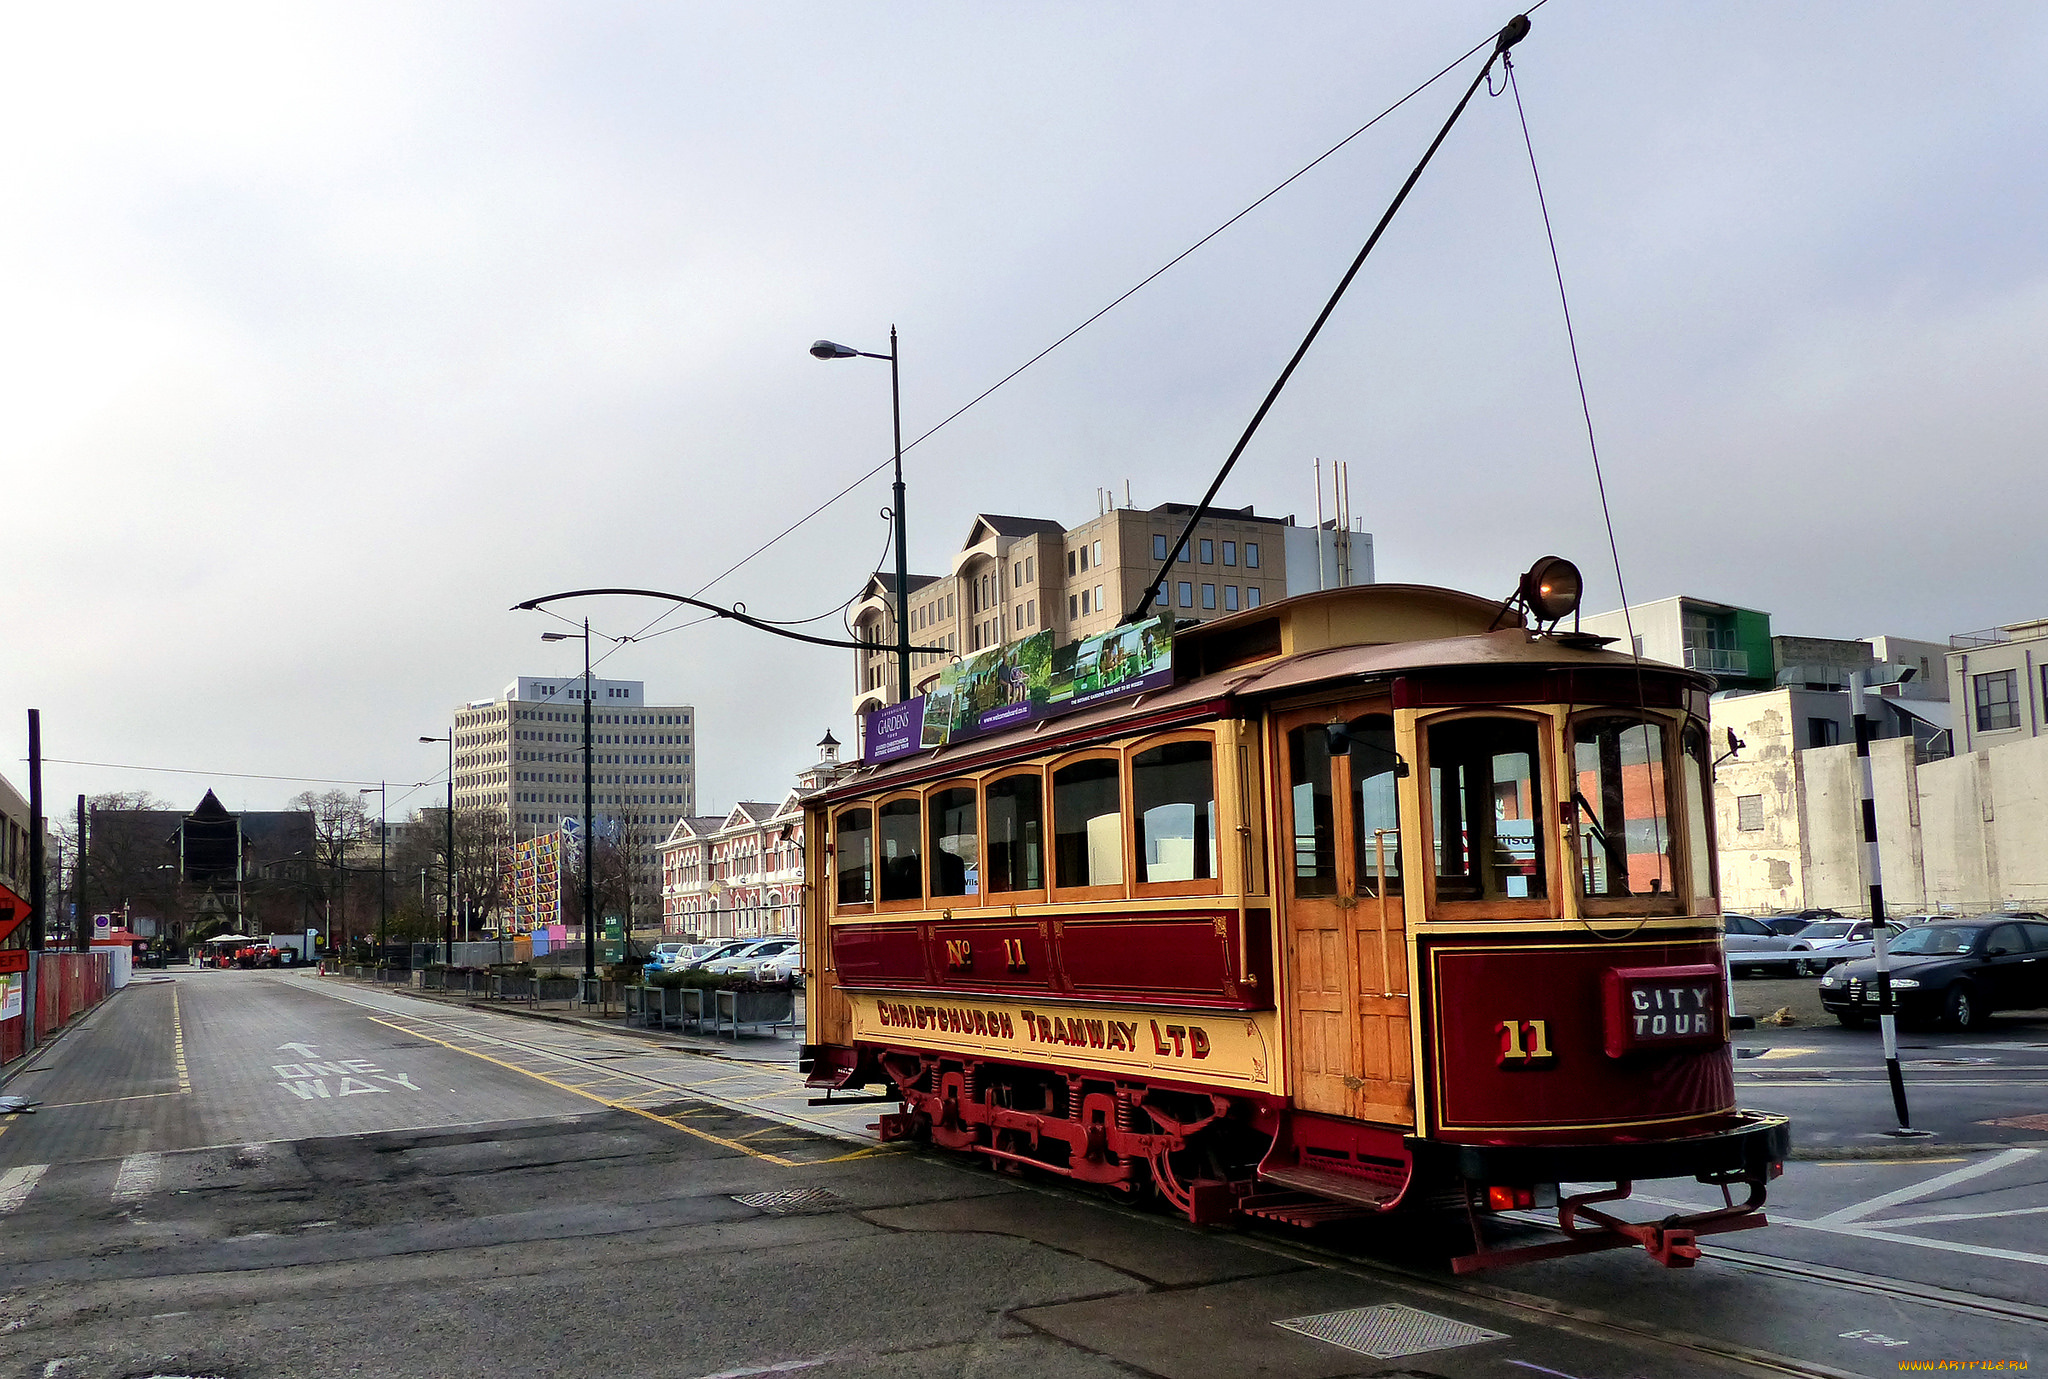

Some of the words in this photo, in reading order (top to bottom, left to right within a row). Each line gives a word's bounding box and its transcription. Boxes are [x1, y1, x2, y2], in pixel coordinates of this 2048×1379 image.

[877, 711, 909, 736] GARDENS
[0, 953, 24, 968] EFT
[1003, 938, 1027, 966] 11
[1631, 988, 1709, 1010] CITY
[876, 999, 1015, 1040] CHRISTCHURCH
[1020, 1009, 1139, 1053] TRAMWAY
[1149, 1018, 1211, 1060] LTD
[1632, 1014, 1709, 1035] TOUR
[1500, 1019, 1553, 1058] 11
[271, 1059, 386, 1080] ONE
[276, 1072, 422, 1100] WAY
